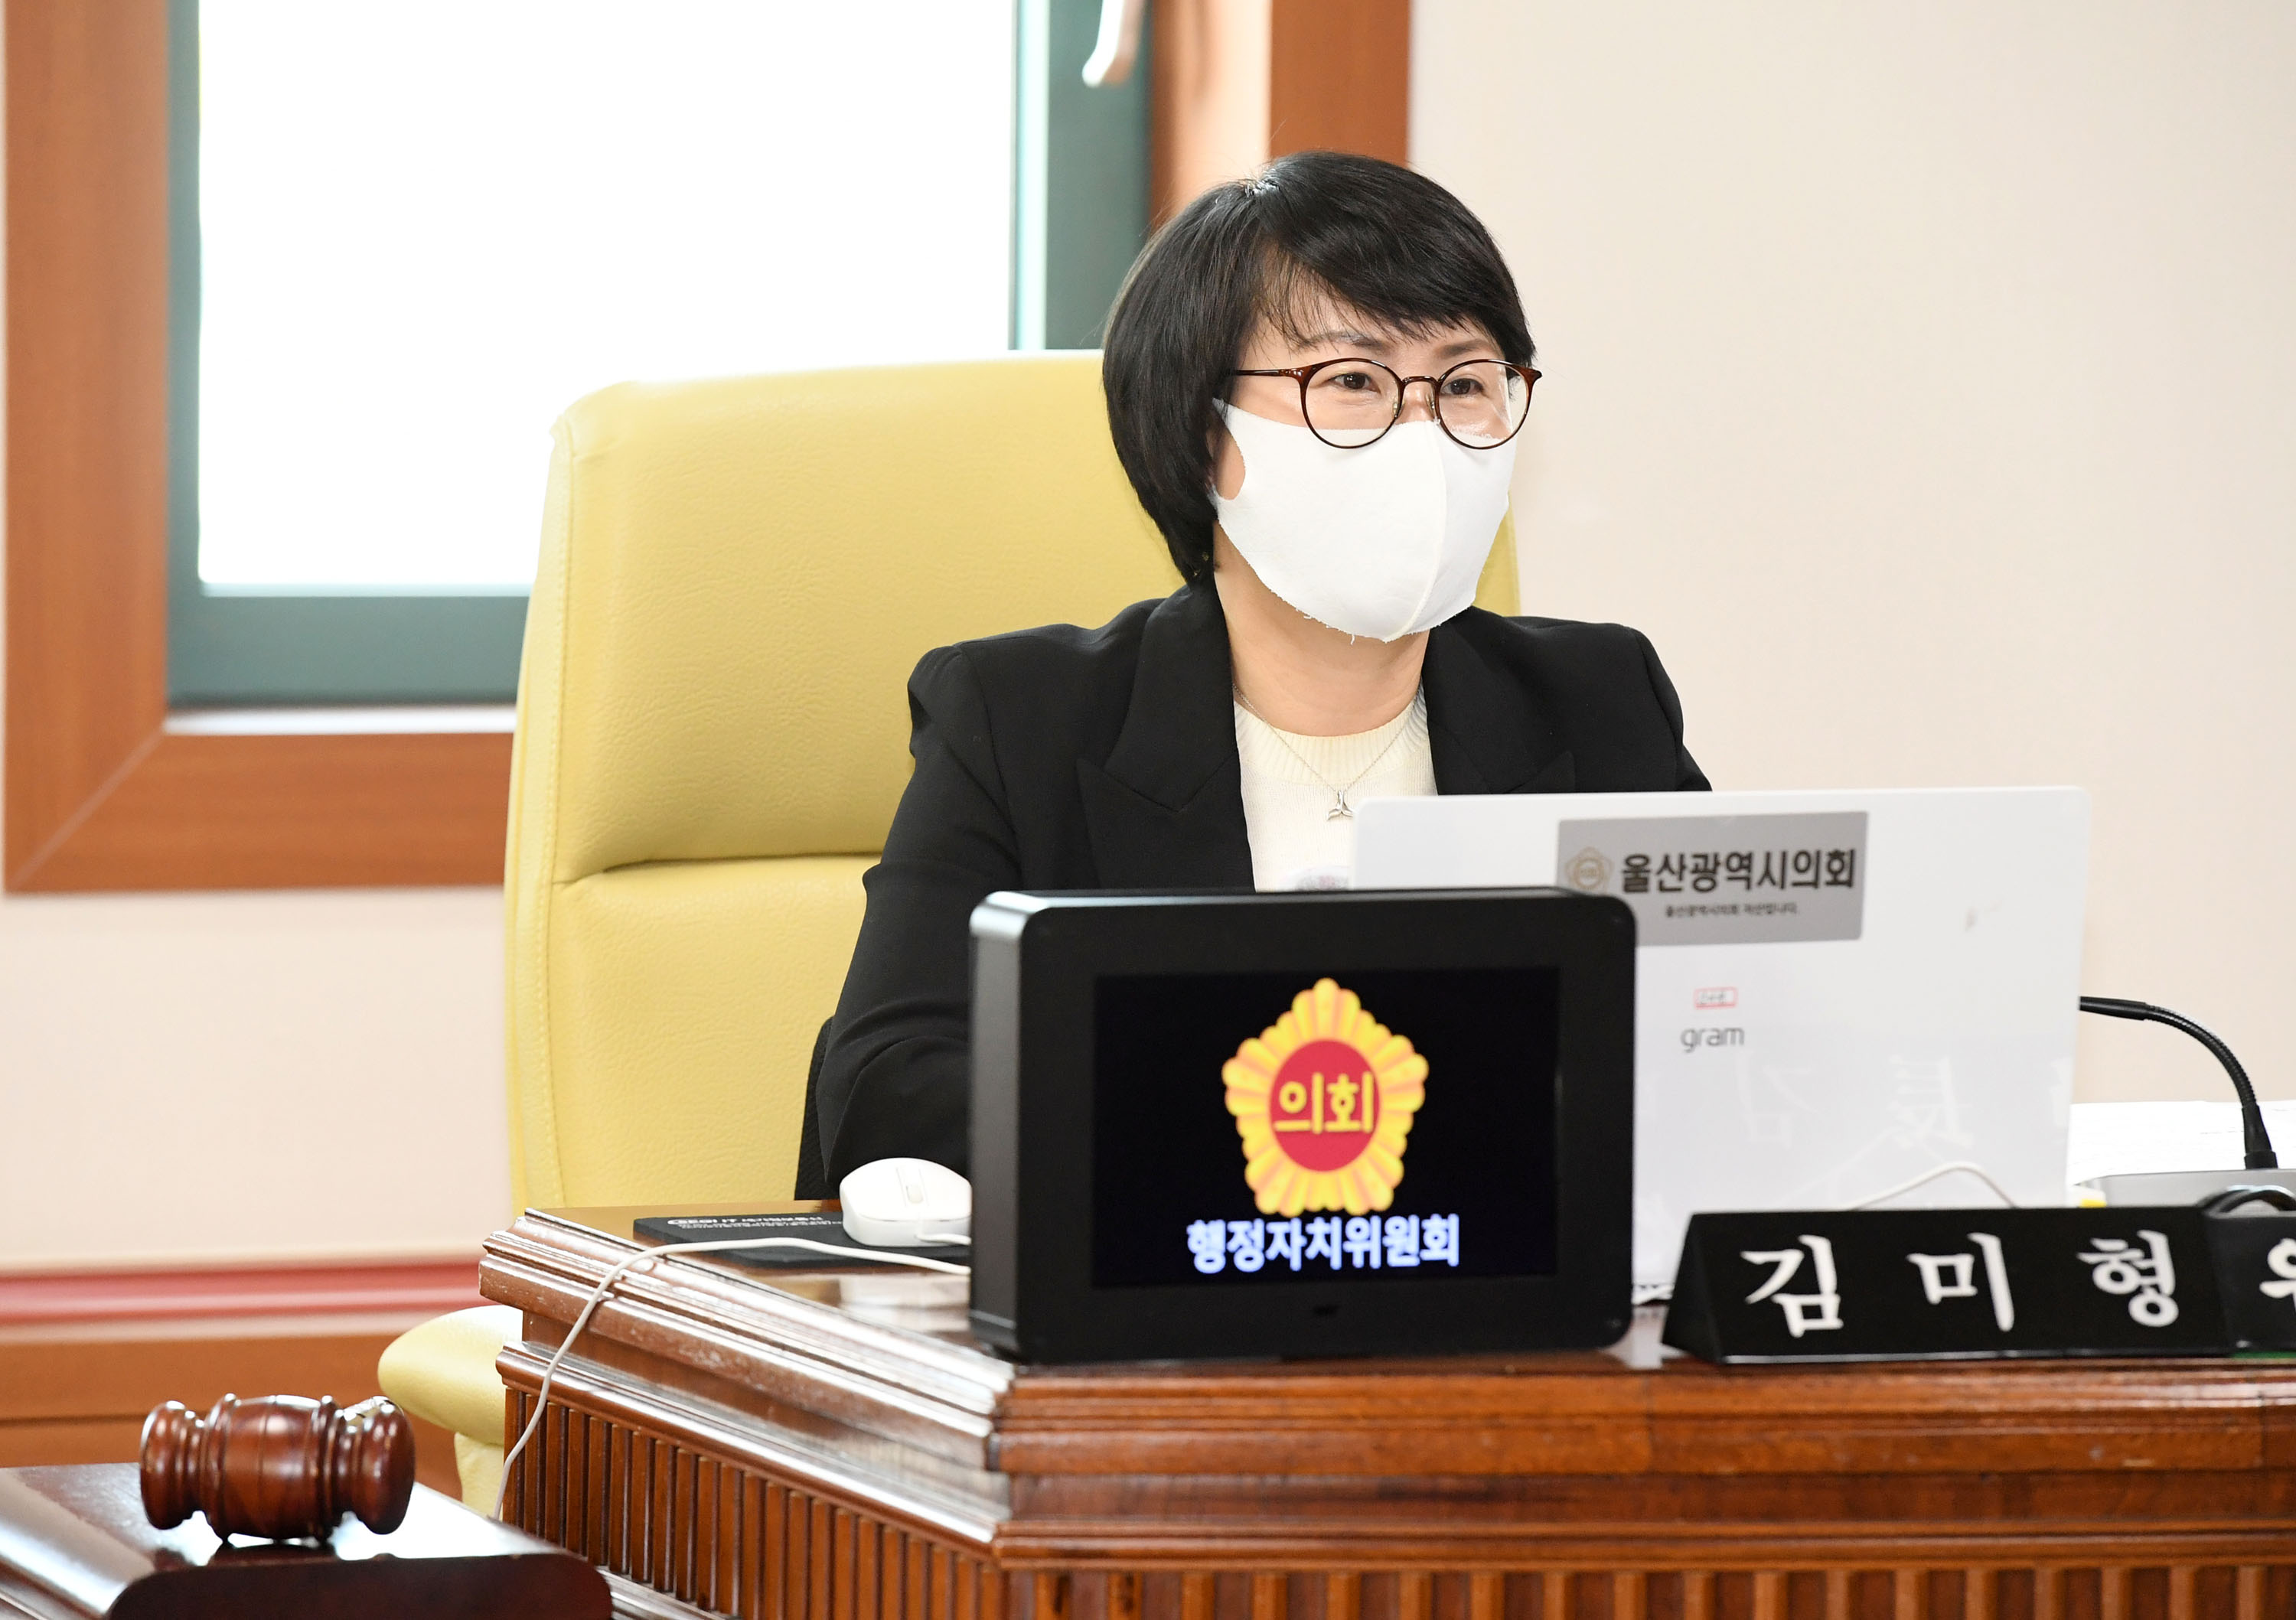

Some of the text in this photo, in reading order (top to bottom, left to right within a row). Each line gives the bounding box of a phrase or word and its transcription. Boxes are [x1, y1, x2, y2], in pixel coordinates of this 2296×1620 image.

[1622, 849, 1856, 894] 울산광역시의회
[1680, 1027, 1744, 1053] gram
[1274, 1072, 1375, 1135] 의회
[1186, 1214, 1459, 1274] 행정자치위원회
[1740, 1234, 1844, 1338] 김
[1907, 1232, 2015, 1332] 미
[2077, 1229, 2180, 1328] 형
